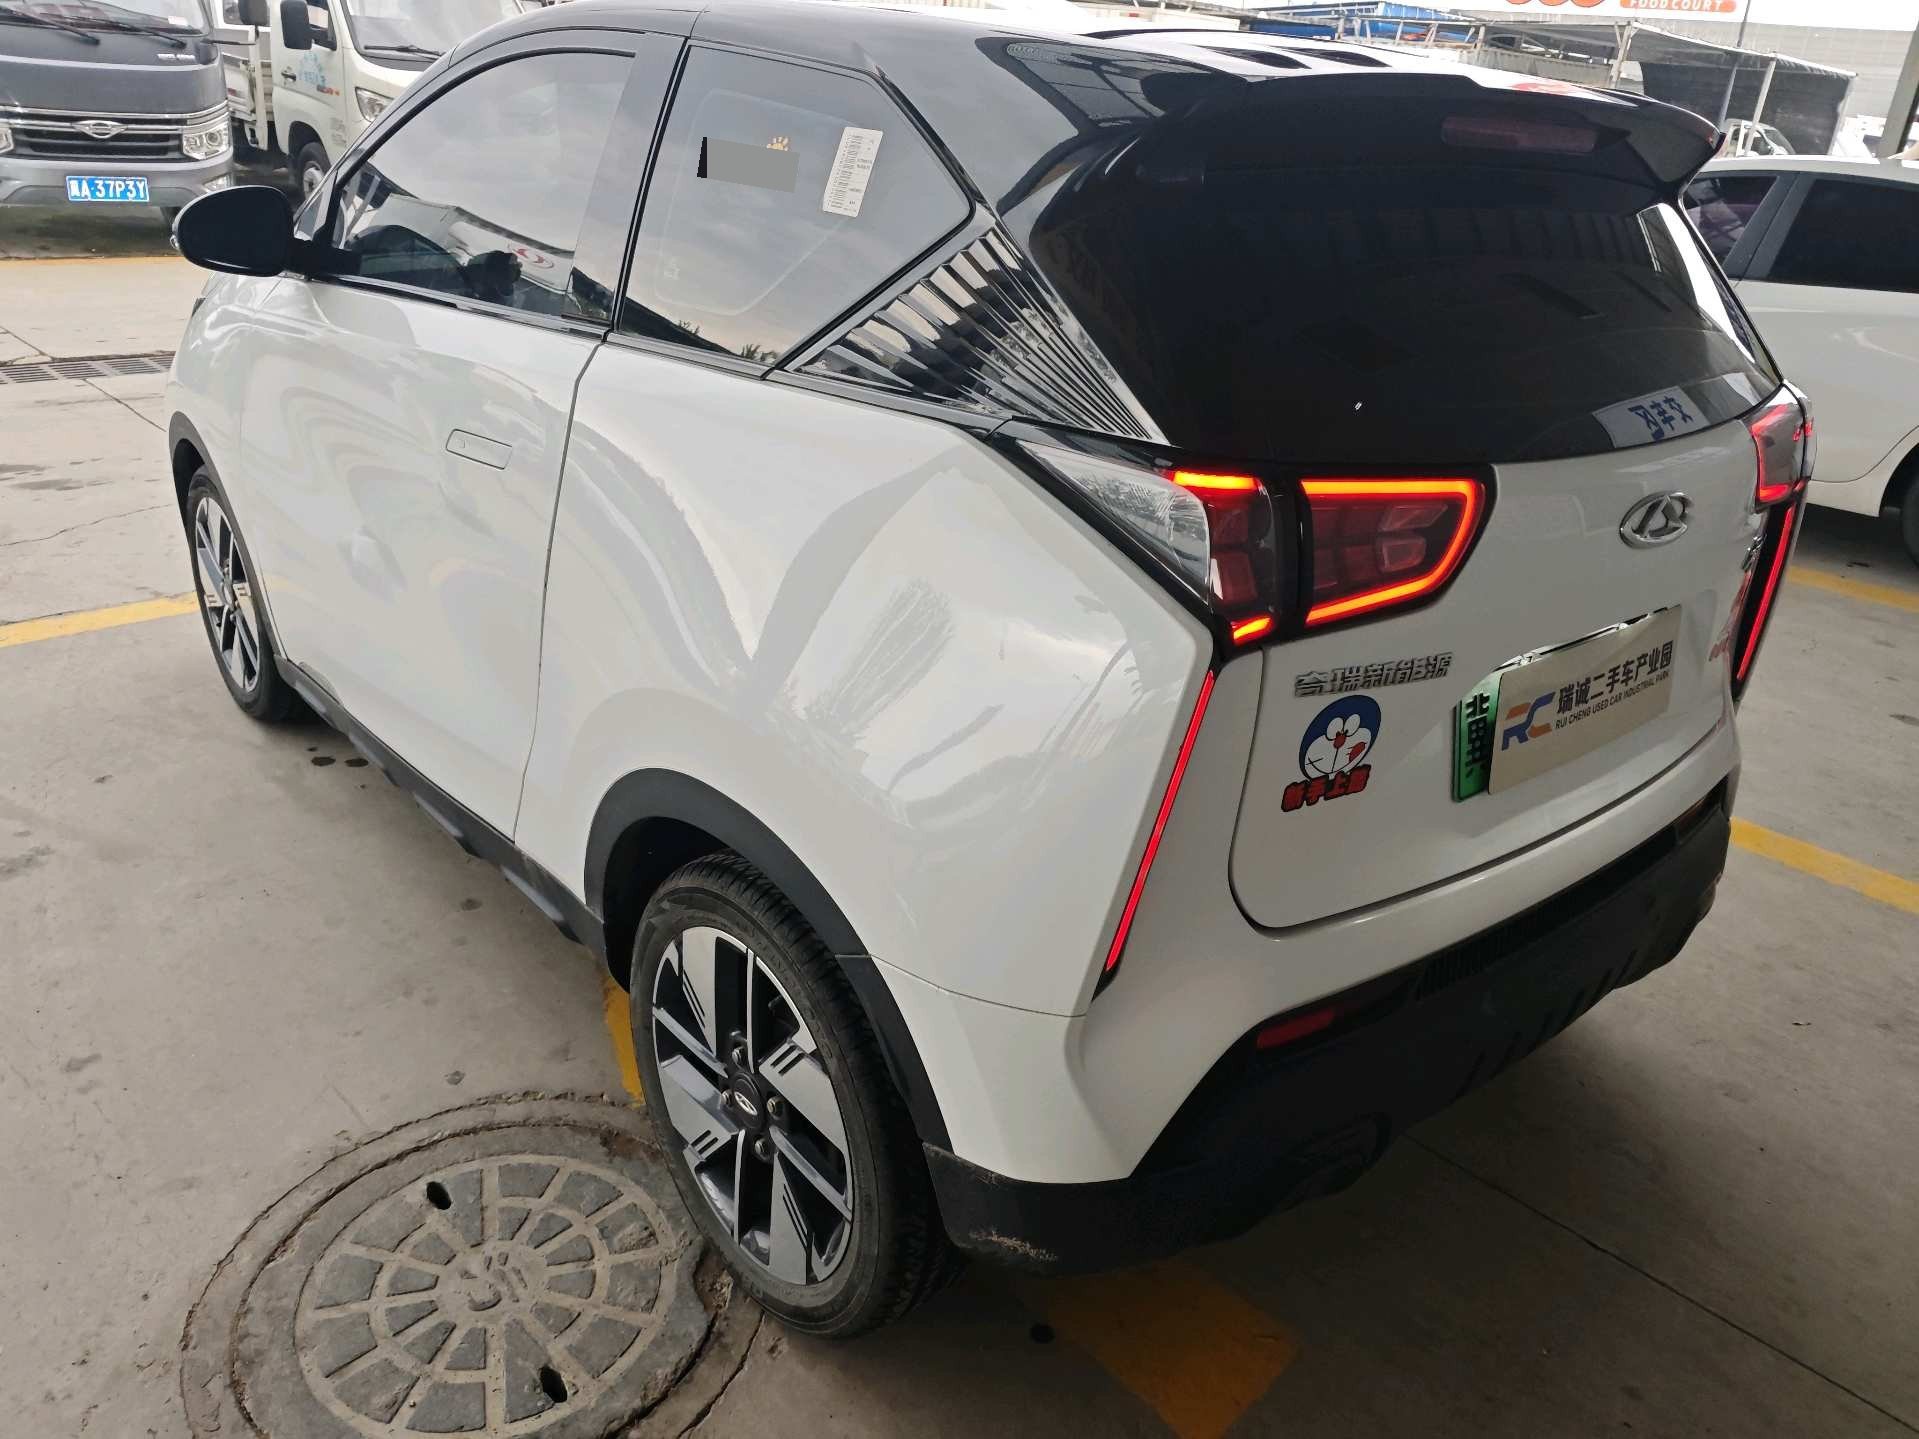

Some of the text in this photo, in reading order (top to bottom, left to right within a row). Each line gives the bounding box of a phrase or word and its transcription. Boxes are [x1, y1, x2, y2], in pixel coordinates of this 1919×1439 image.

[1629, 0, 1721, 12] FOOD COURT
[1294, 651, 1453, 698] 奇瑞新能源
[1556, 639, 1674, 714] 瑞诚二手车产业园
[1555, 716, 1568, 729] RUI
[1569, 706, 1591, 724] CHENG
[1592, 698, 1609, 714] USED
[1610, 692, 1622, 706] CAR
